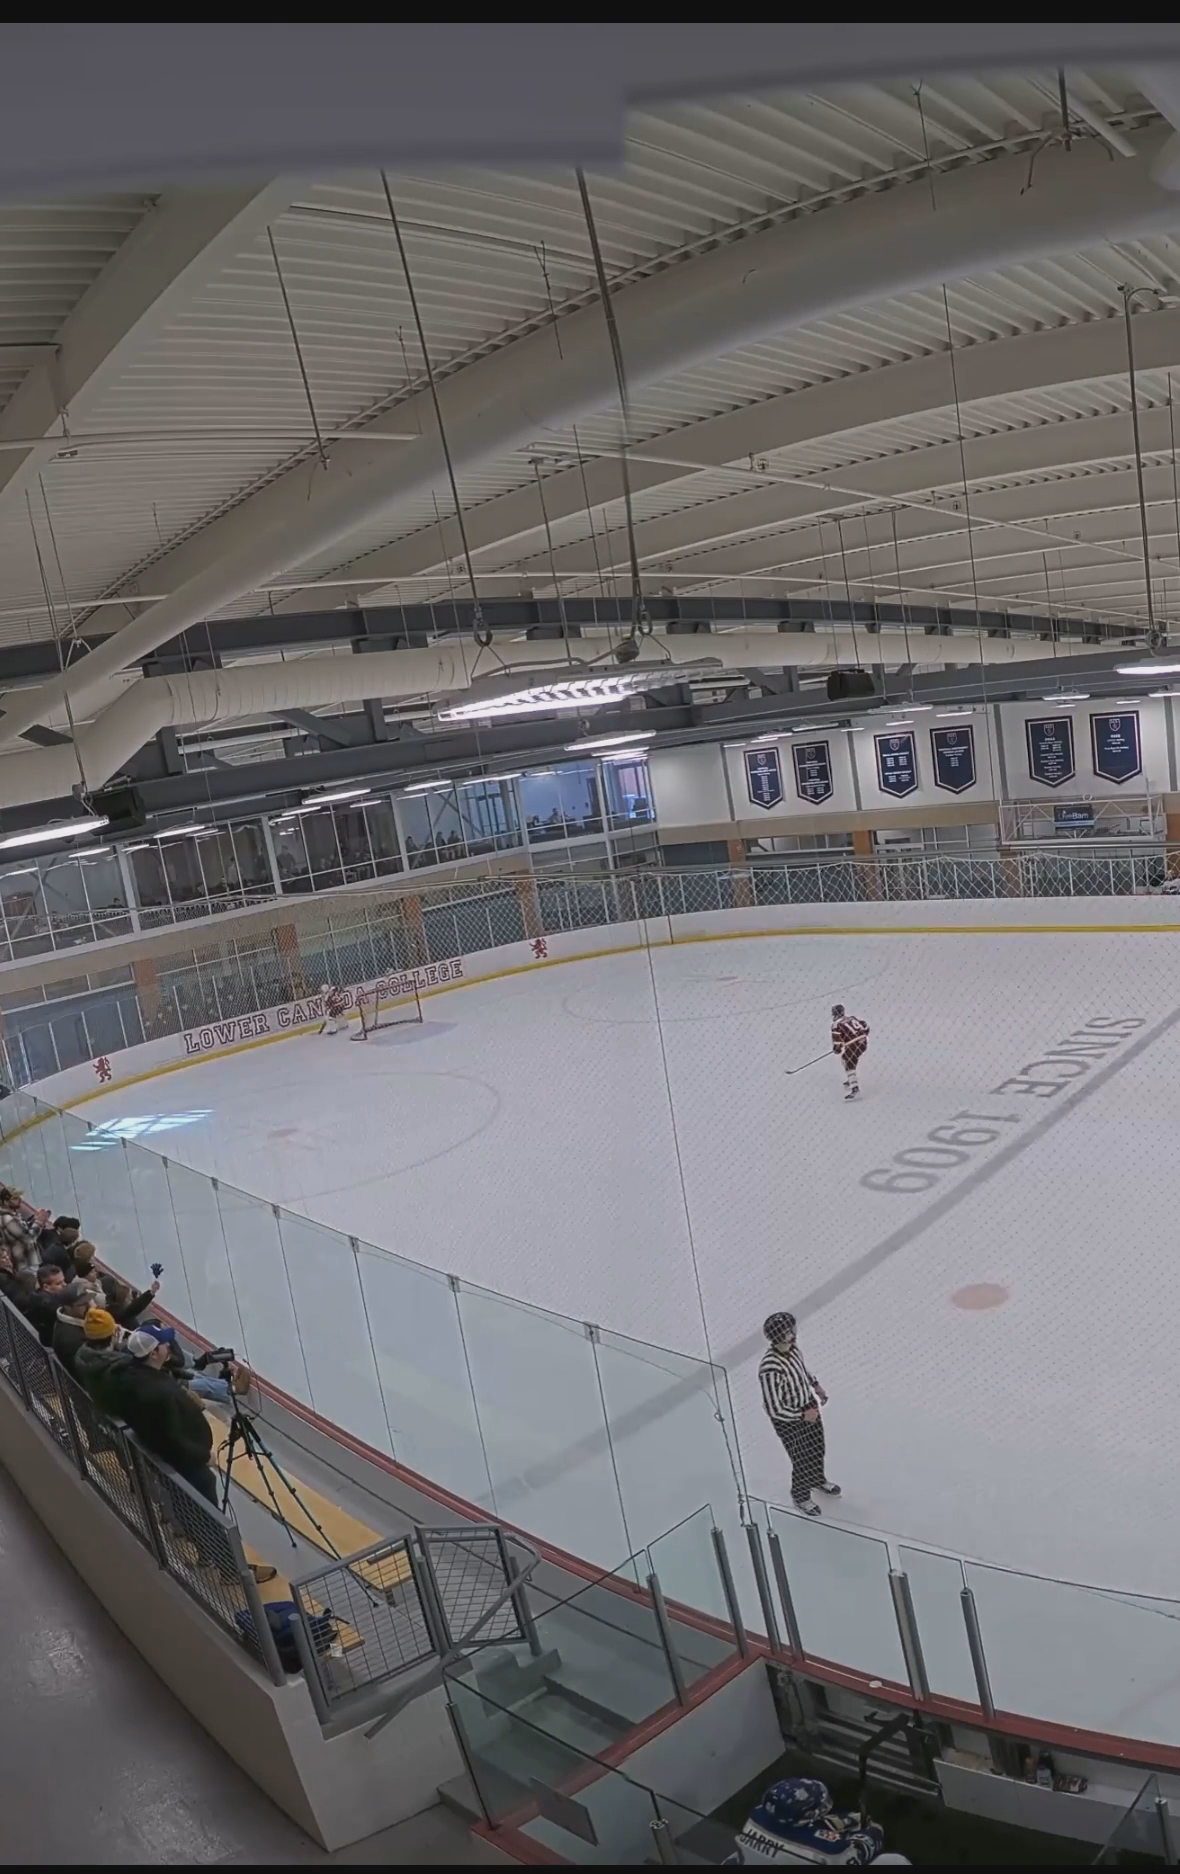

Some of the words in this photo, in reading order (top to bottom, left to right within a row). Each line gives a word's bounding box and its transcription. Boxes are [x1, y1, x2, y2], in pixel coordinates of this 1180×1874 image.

[184, 1013, 270, 1054] LOWER
[277, 986, 370, 1028] CANDA
[376, 959, 463, 1000] COLLEGE
[989, 1016, 1147, 1099] SINCE
[859, 1109, 1022, 1194] 1909
[740, 1829, 785, 1859] JARRY
